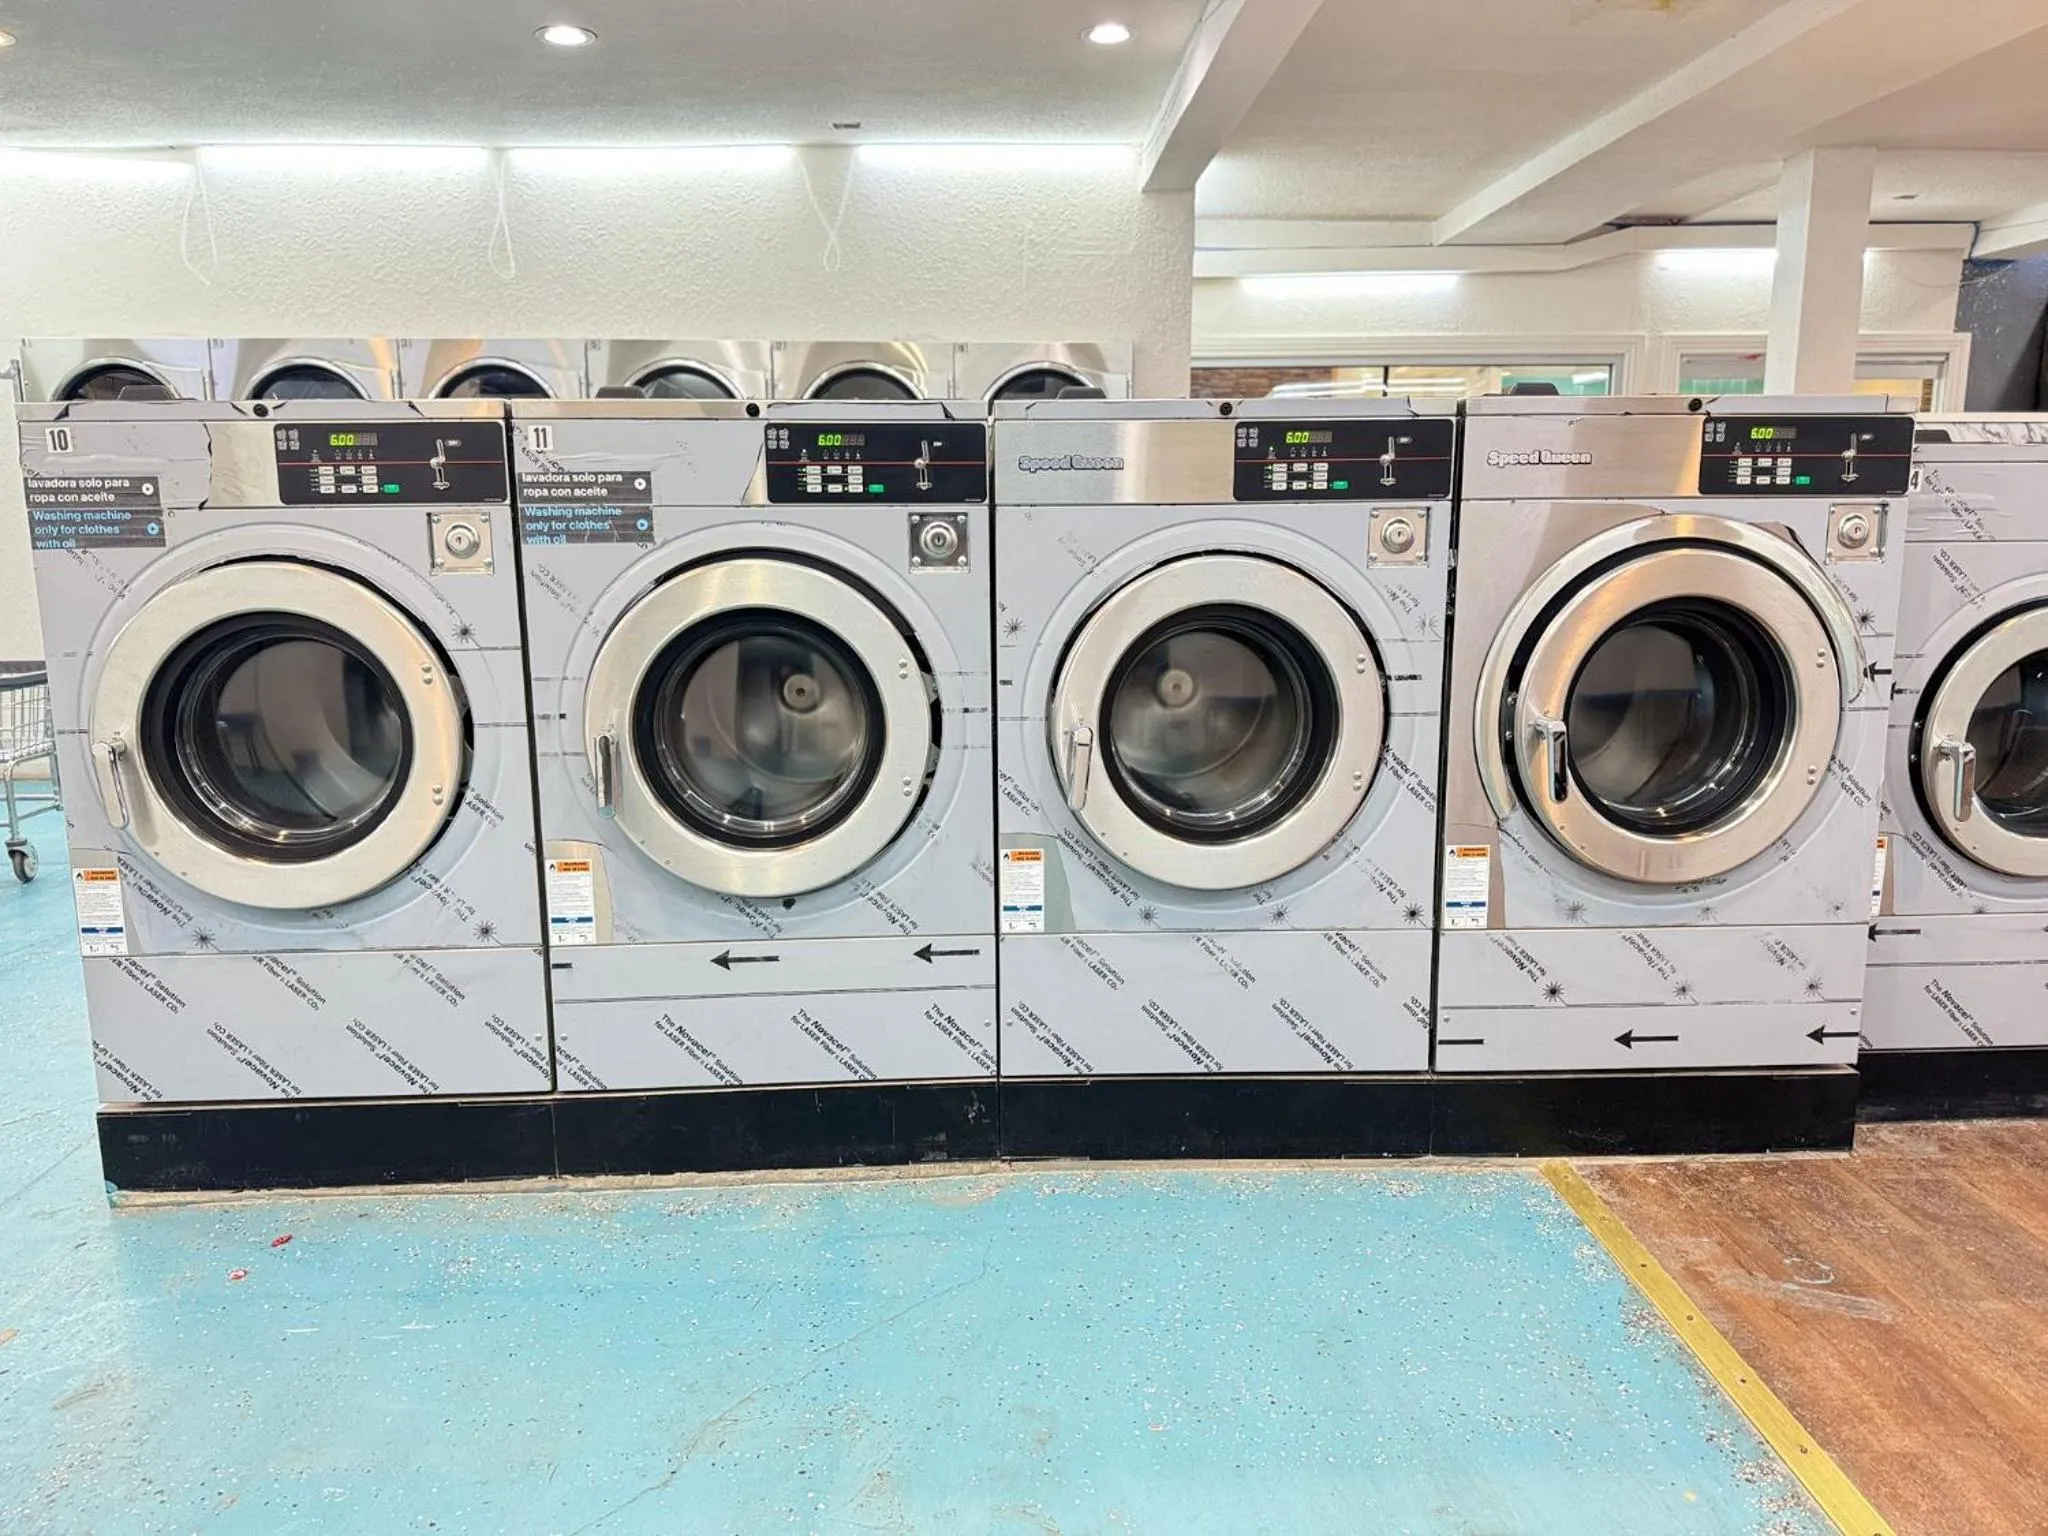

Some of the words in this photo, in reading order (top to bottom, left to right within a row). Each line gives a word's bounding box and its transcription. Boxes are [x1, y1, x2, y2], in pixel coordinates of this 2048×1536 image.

[49, 429, 69, 451] 10
[533, 427, 548, 449] 11
[1487, 449, 1540, 468] Speed
[1541, 449, 1592, 465] Queen
[28, 478, 76, 488] lavadora
[79, 478, 102, 488] solo
[105, 479, 130, 488] para
[522, 472, 570, 483] lavadora
[572, 472, 596, 482] solo
[598, 474, 622, 484] para
[29, 494, 55, 504] ropa
[57, 494, 78, 502] con
[81, 492, 115, 502] aceite
[523, 488, 549, 498] ropa
[550, 488, 571, 496] con
[573, 487, 608, 497] aceite
[33, 511, 81, 521] Washing
[84, 511, 131, 520] machine
[524, 507, 572, 517] Washing
[575, 506, 622, 516] machine
[35, 525, 59, 536] only
[61, 525, 76, 535] for
[79, 525, 120, 534] clothes
[526, 522, 549, 532] only
[551, 520, 567, 530] for
[569, 520, 610, 530] clothes
[36, 539, 60, 548] with
[62, 539, 76, 548] oil
[527, 534, 551, 544] with
[553, 534, 566, 544] oil
